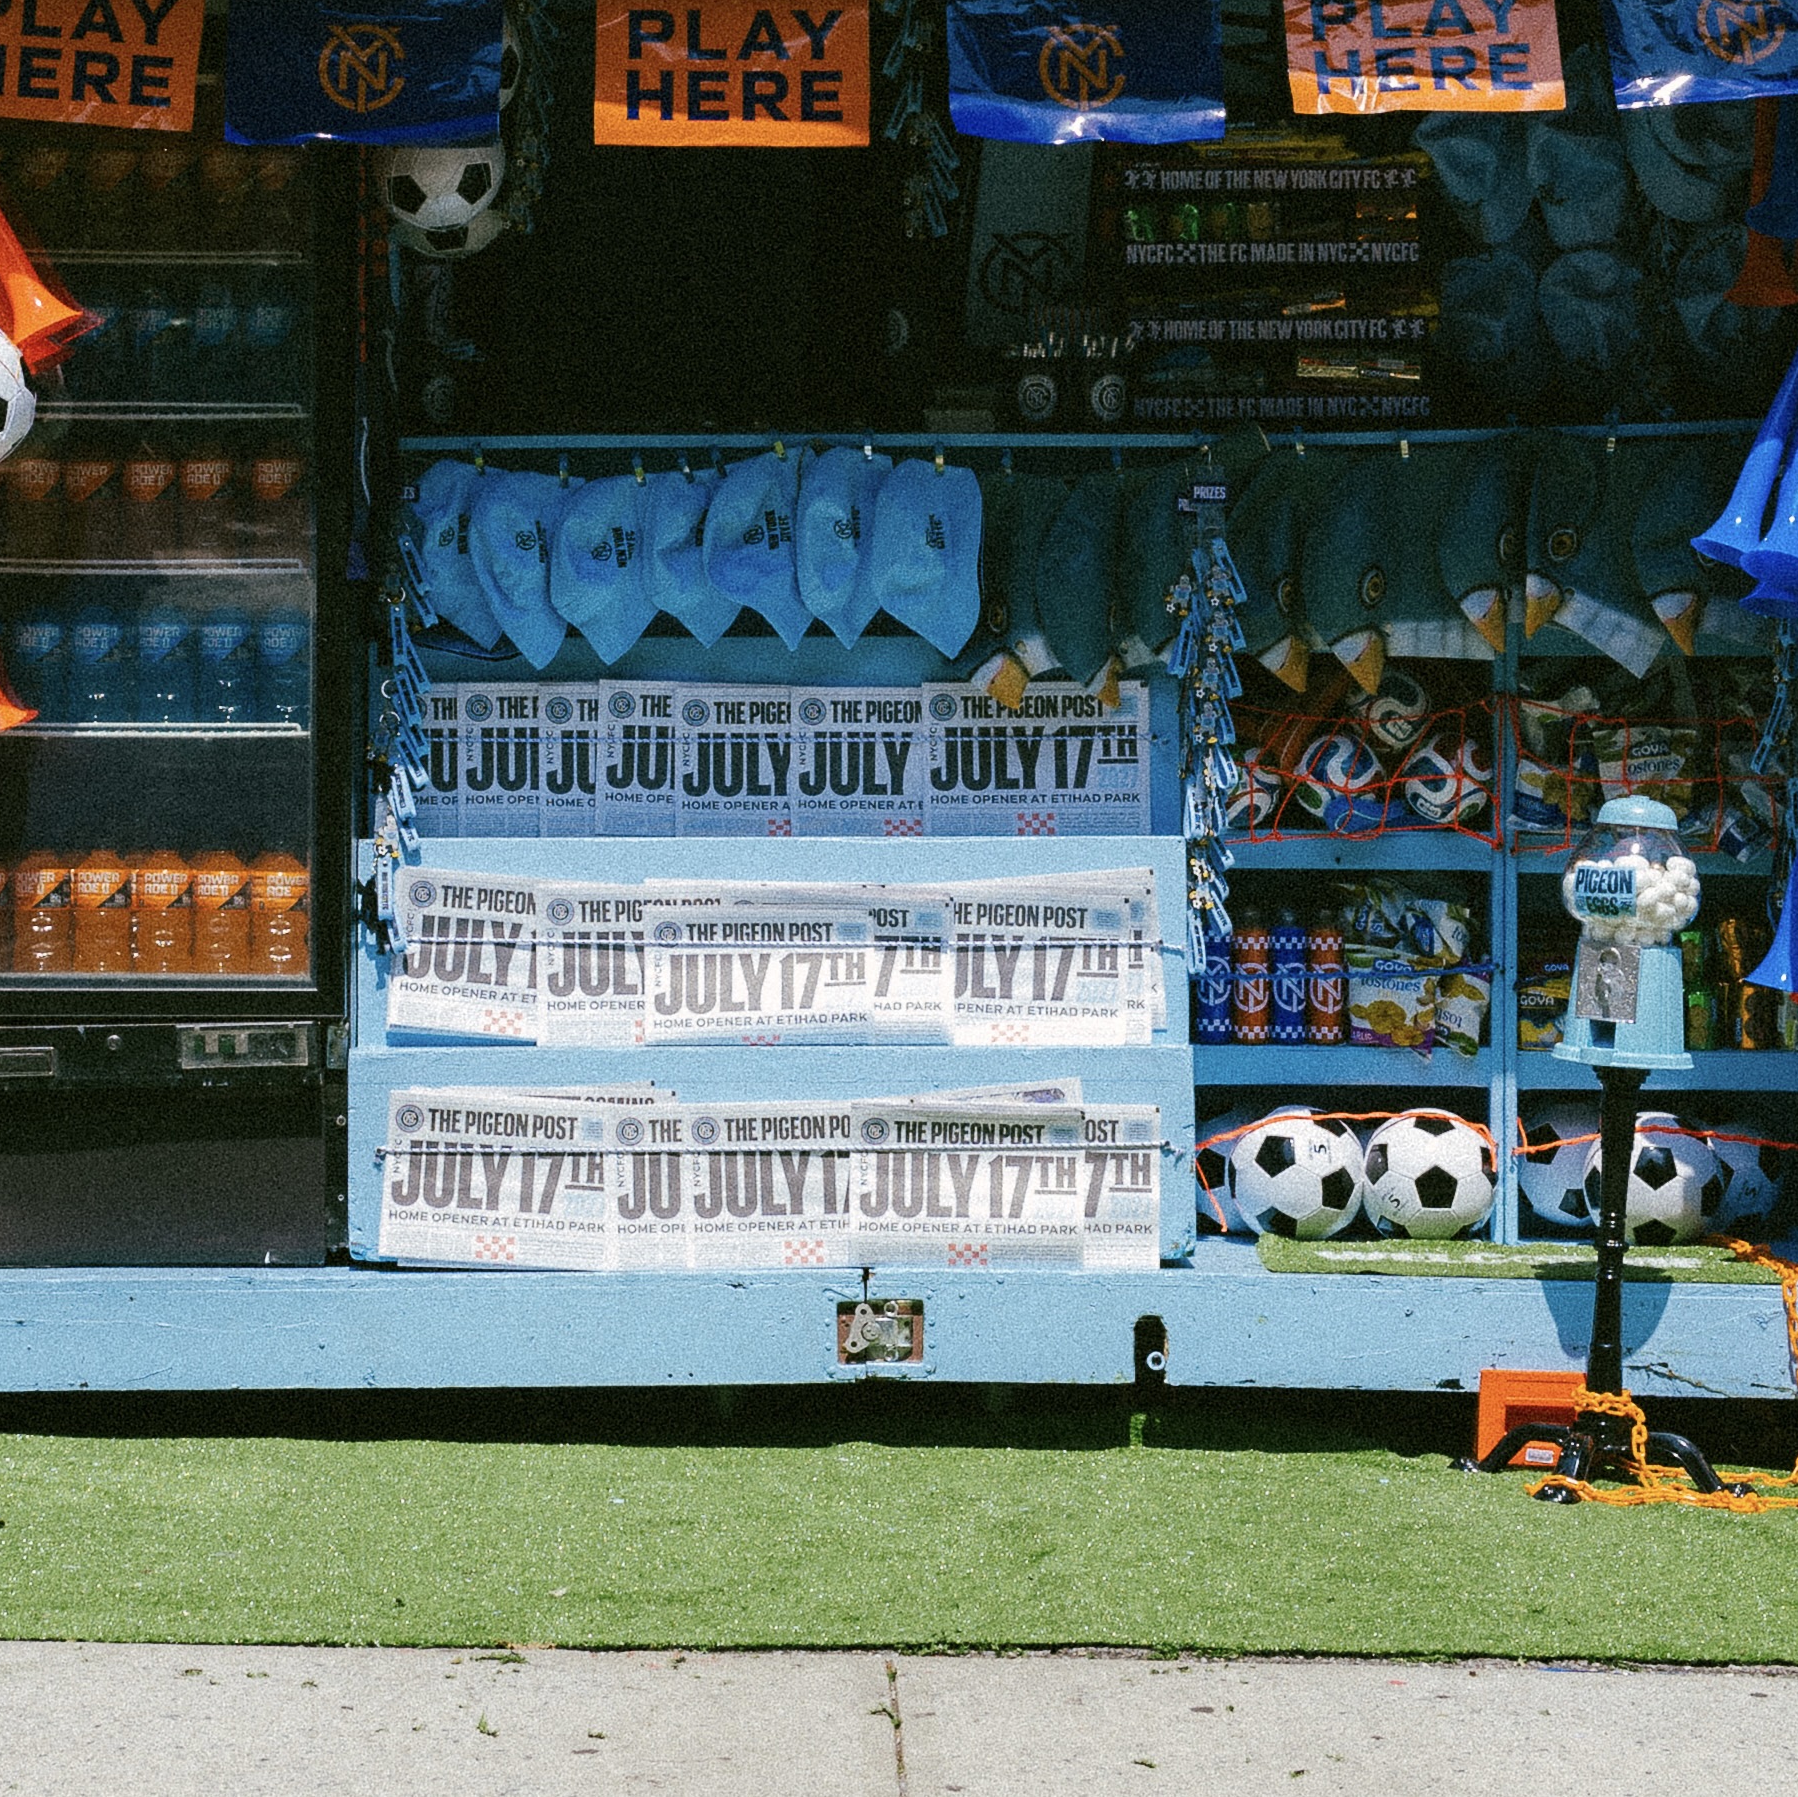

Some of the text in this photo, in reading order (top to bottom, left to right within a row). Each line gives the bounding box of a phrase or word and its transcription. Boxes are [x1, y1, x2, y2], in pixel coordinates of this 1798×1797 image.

[625, 7, 844, 63] PLAY
[1311, 43, 1534, 100] HERE
[625, 69, 844, 124] HERE
[1161, 170, 1380, 189] HOME OF THE NEW YORK CITY FC
[1127, 243, 1419, 264] NYCFC THE FC MADE IN NYC NYCFC
[1194, 486, 1226, 499] PRIZES
[961, 696, 996, 718] THE
[1062, 695, 1104, 717] POST
[929, 724, 1138, 792] JULY 17TH
[1632, 743, 1669, 756] GOYA
[1627, 756, 1684, 774] ostones
[931, 792, 1140, 804] HOME OPENER AT ETIHAD PARK
[77, 872, 120, 883] POWER
[144, 873, 188, 884] POWER
[197, 874, 239, 885] POWER
[1575, 868, 1632, 894] PIGEON
[1586, 896, 1619, 915] EGGS
[687, 922, 834, 943] THE PIGEON POST
[1375, 960, 1412, 972] GOYA
[1544, 963, 1570, 972] GOYA
[654, 951, 866, 1015] JULY 17TH
[1519, 995, 1555, 1006] GOYA
[894, 1119, 1045, 1145] THE PIGEON POST
[859, 1150, 1077, 1219] JULY 17TH
